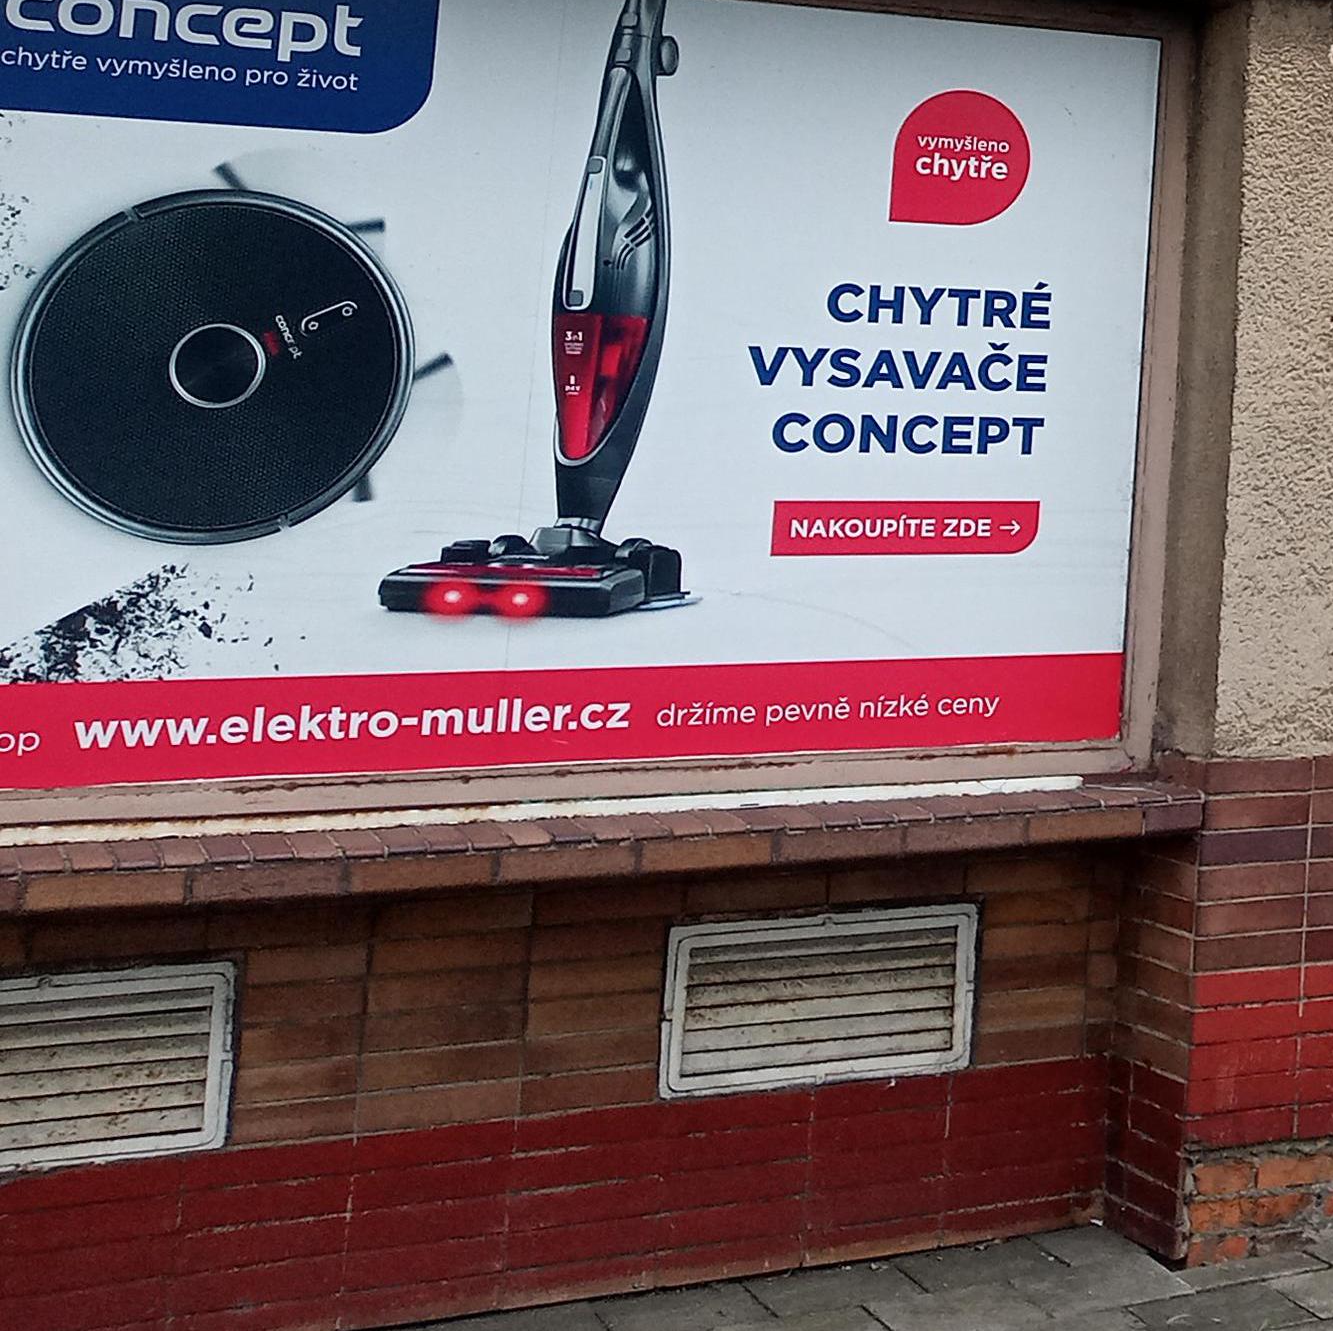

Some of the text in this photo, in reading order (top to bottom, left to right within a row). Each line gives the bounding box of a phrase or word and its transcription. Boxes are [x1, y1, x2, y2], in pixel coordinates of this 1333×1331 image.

[1, 45, 359, 92] chytře vymyšleno pro život
[915, 151, 1009, 181] chytře
[917, 133, 1010, 155] vymyšleno
[826, 281, 1053, 330] CHYTRÉ
[747, 341, 1049, 393] VYSAVAČE
[771, 412, 1046, 456] CONCEPT
[790, 513, 992, 539] NAKOUPÍTE ZDE
[0, 693, 1000, 755] op www.elektro-muller.cz držíme pevně nízké ceny
